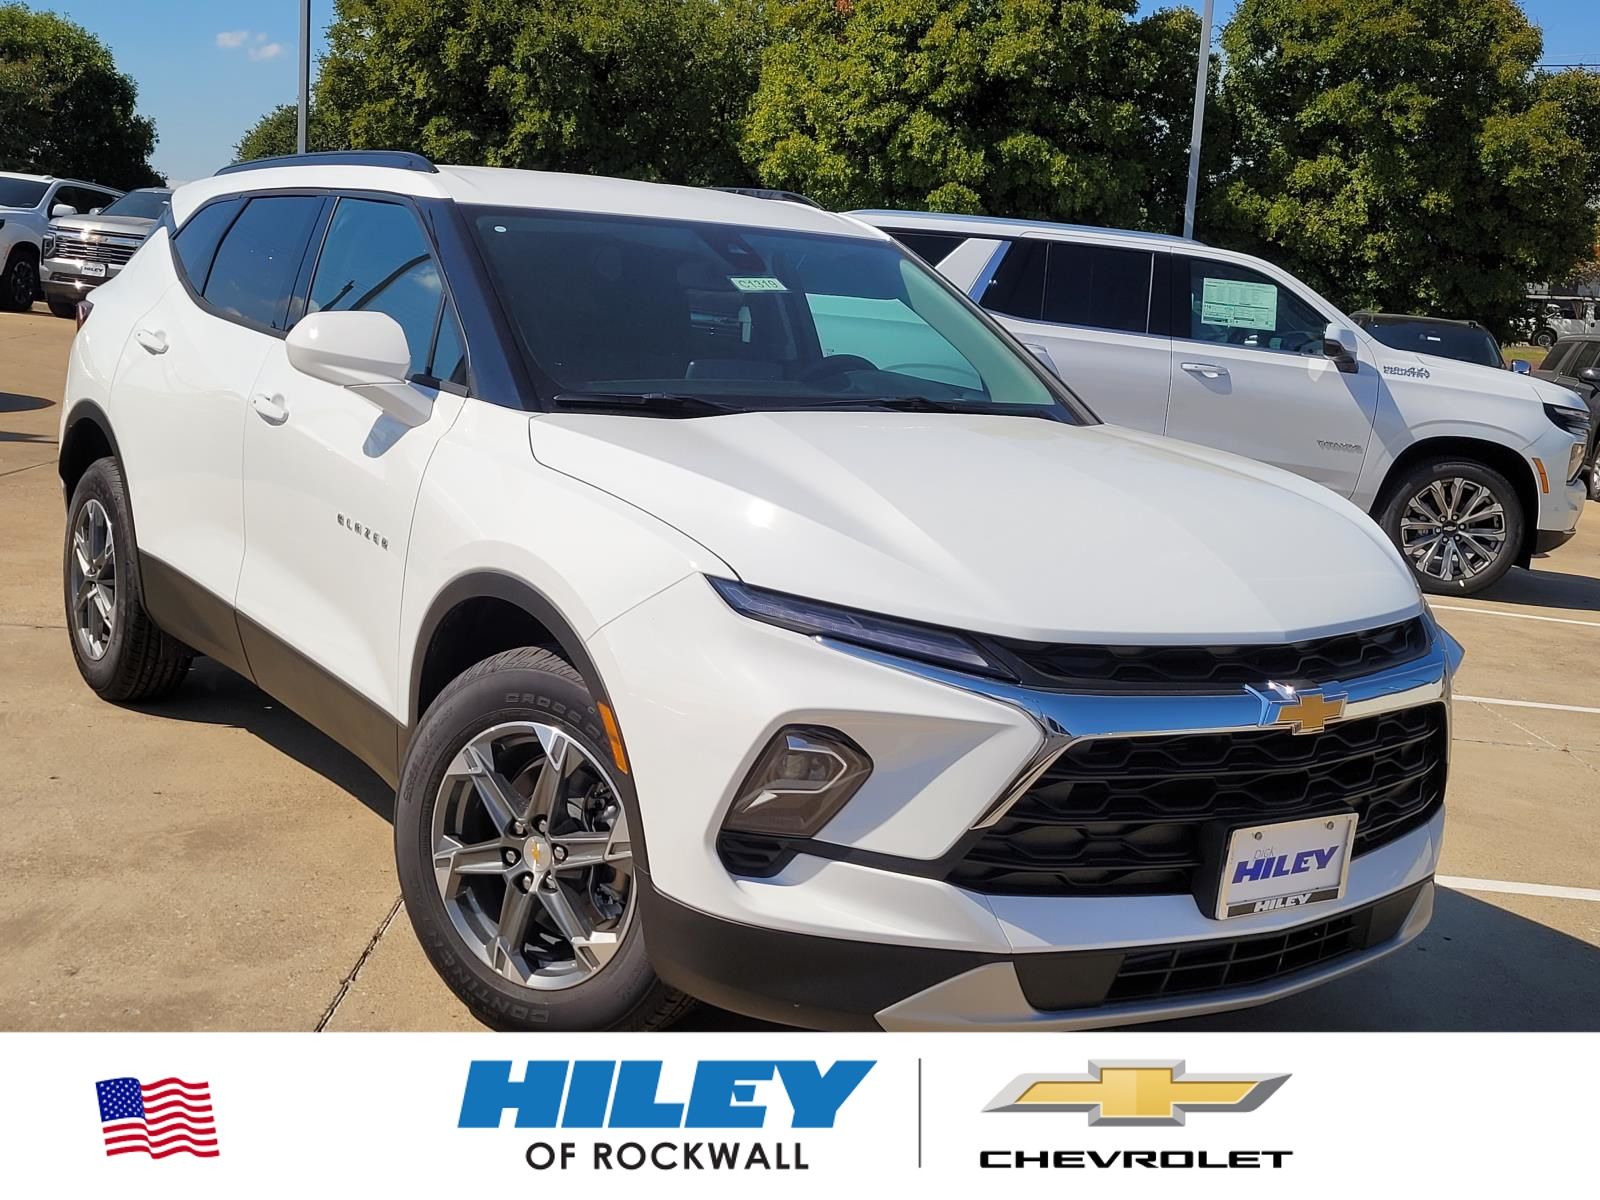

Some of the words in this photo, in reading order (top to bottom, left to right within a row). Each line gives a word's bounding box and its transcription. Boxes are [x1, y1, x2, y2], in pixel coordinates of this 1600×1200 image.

[738, 280, 779, 289] C1319
[337, 513, 389, 551] BLAZER
[1232, 846, 1339, 884] HILEY
[1254, 893, 1312, 913] HILEY
